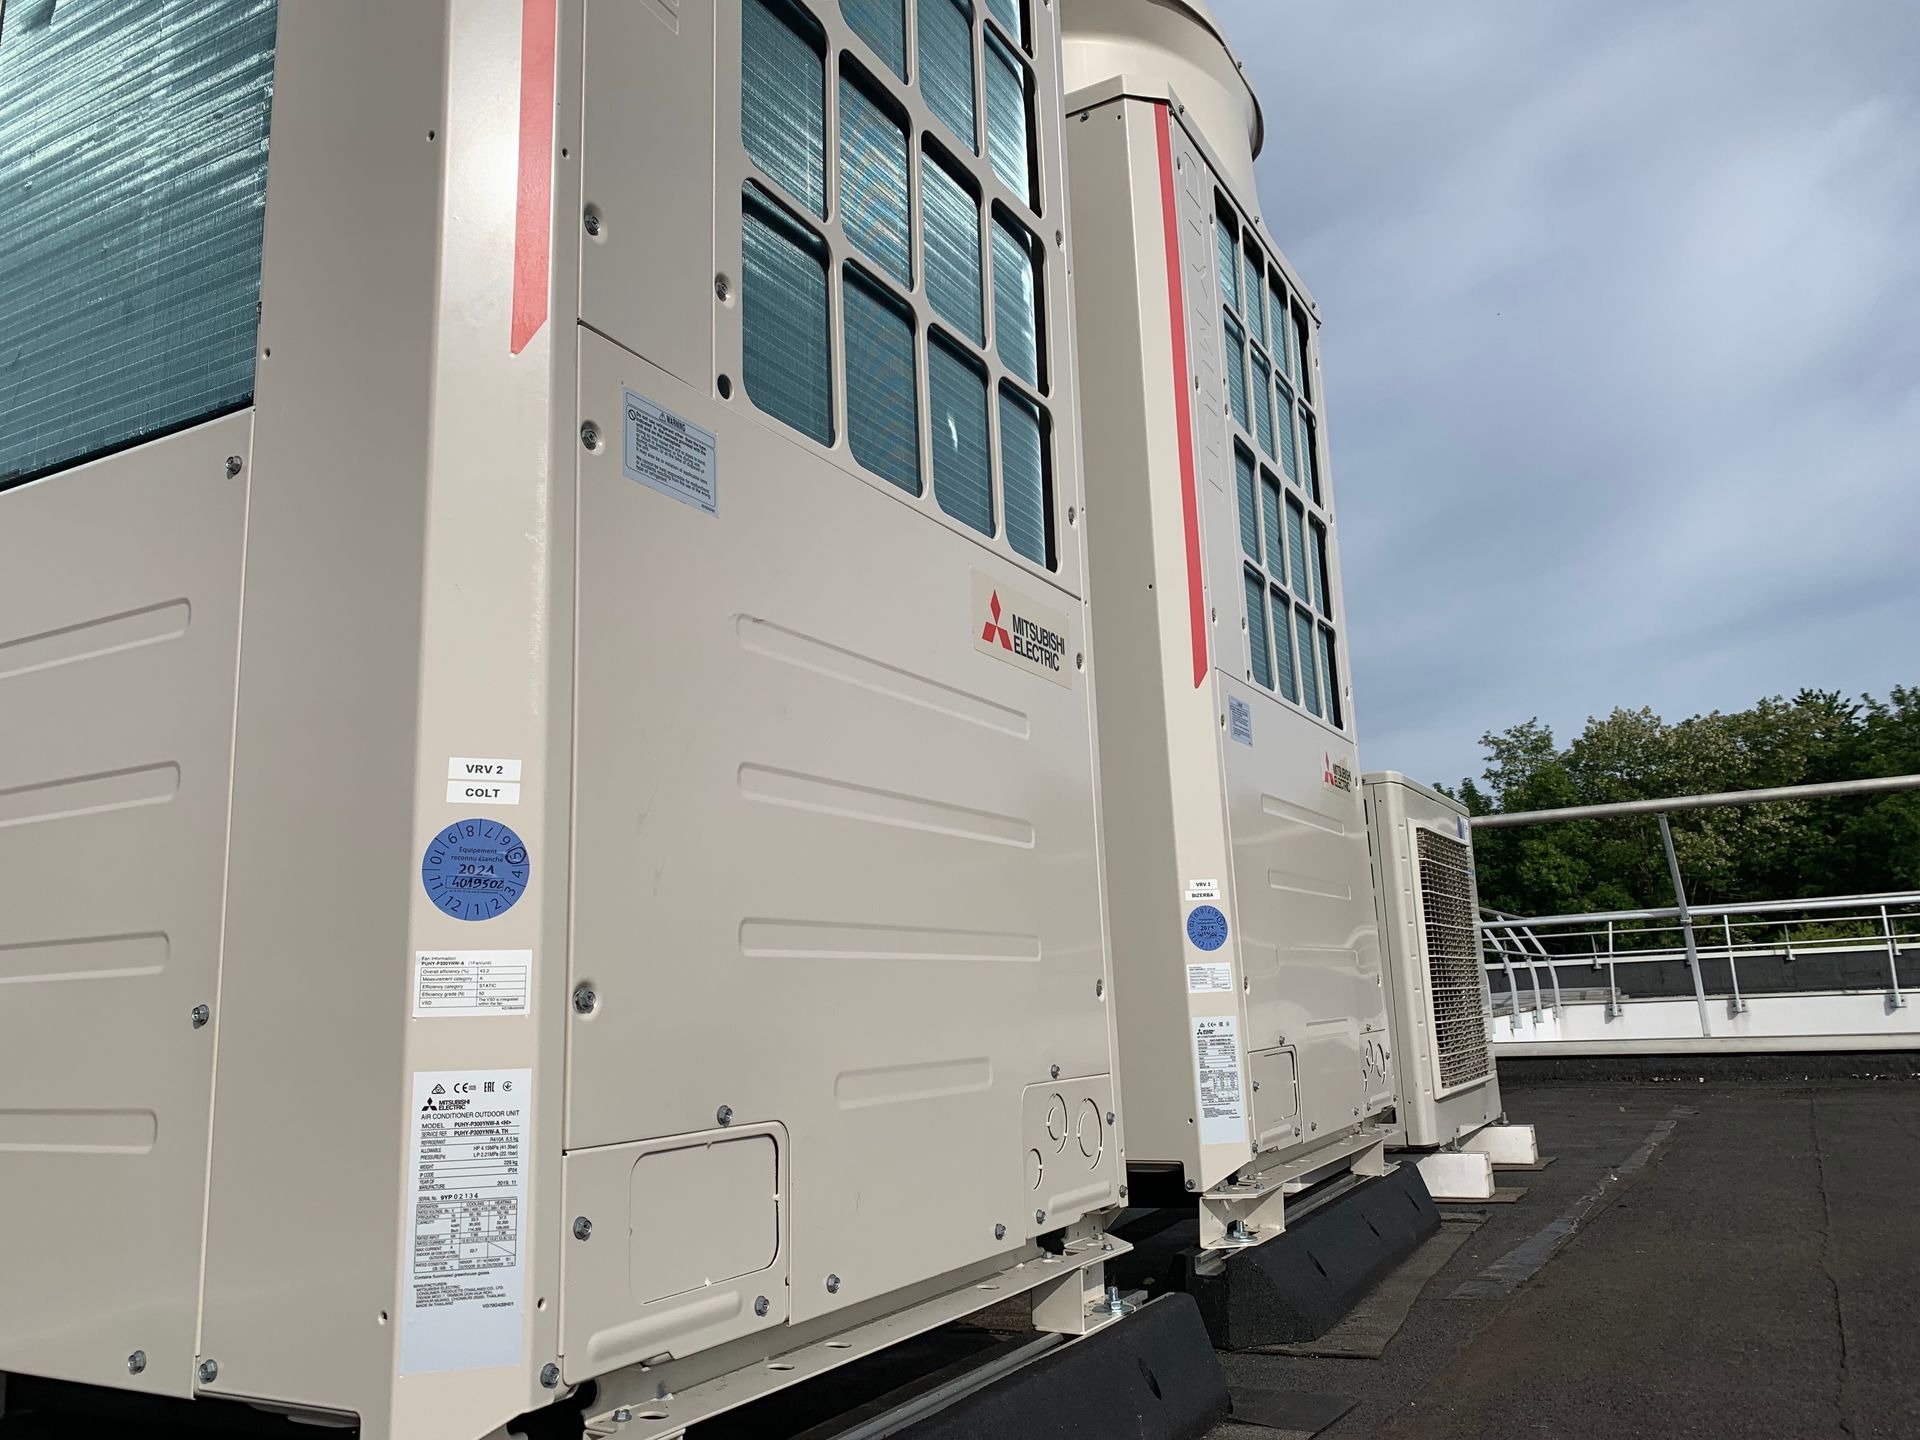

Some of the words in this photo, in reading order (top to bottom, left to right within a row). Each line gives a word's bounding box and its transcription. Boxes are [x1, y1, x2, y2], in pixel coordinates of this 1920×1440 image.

[1012, 613, 1065, 655] MITSUBISHI
[1014, 635, 1060, 672] ELECTRIC
[466, 764, 493, 774] VRV
[496, 765, 503, 774] 2
[465, 788, 500, 798] COLT
[432, 1112, 474, 1120] CONDITIONER
